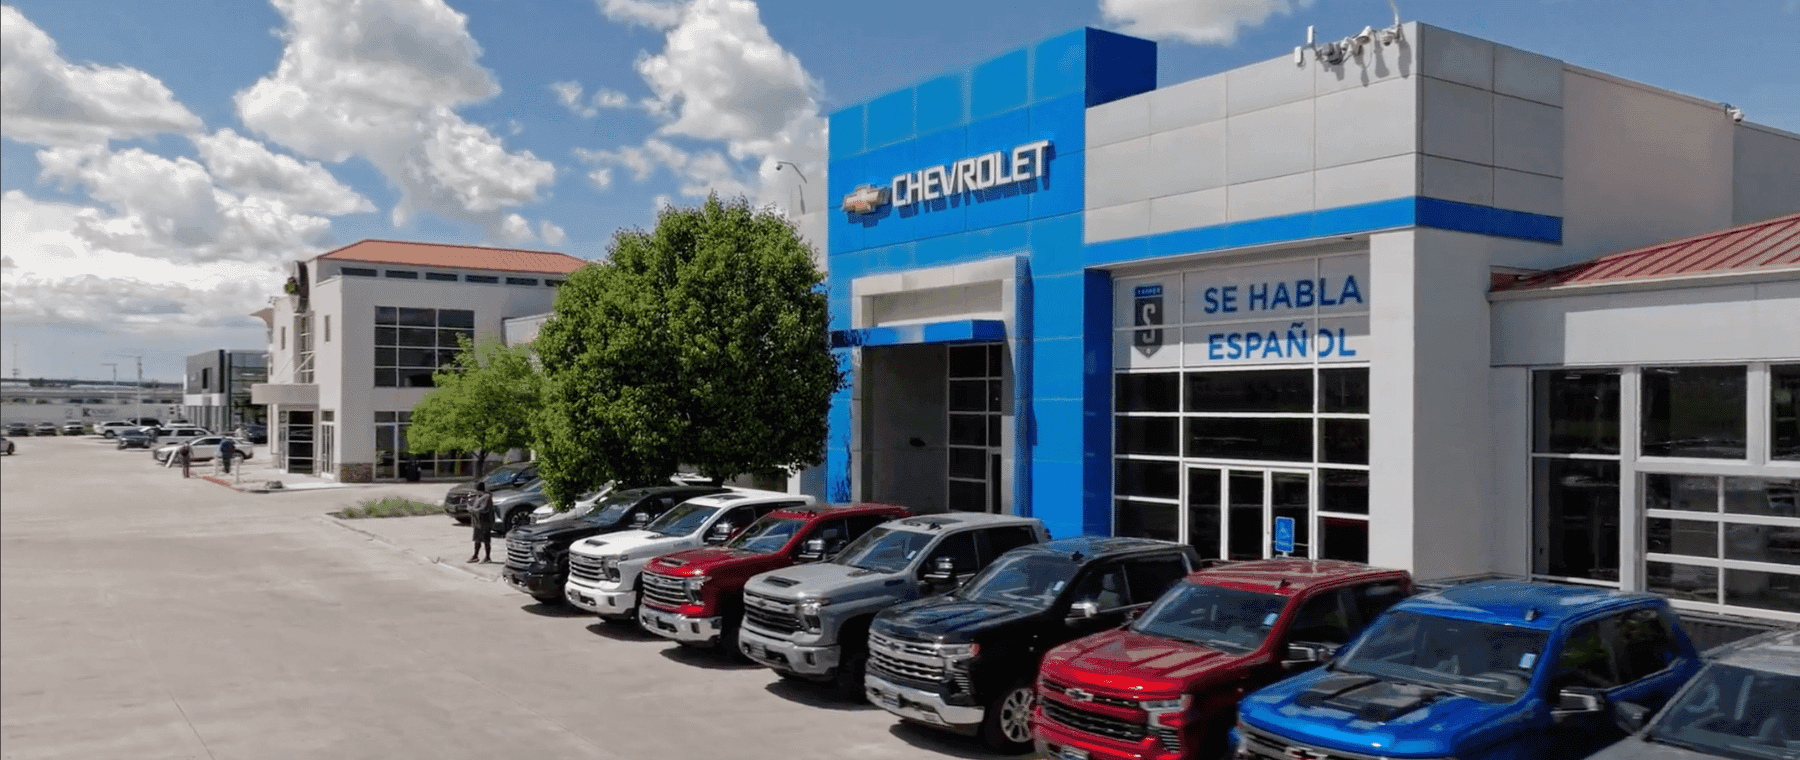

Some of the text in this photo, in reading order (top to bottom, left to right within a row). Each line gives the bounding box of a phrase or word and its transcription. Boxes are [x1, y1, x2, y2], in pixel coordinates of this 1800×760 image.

[892, 139, 1050, 207] CHEVROLET
[1203, 275, 1364, 314] SE HABLA
[1208, 321, 1357, 361] ESPAÑOL
